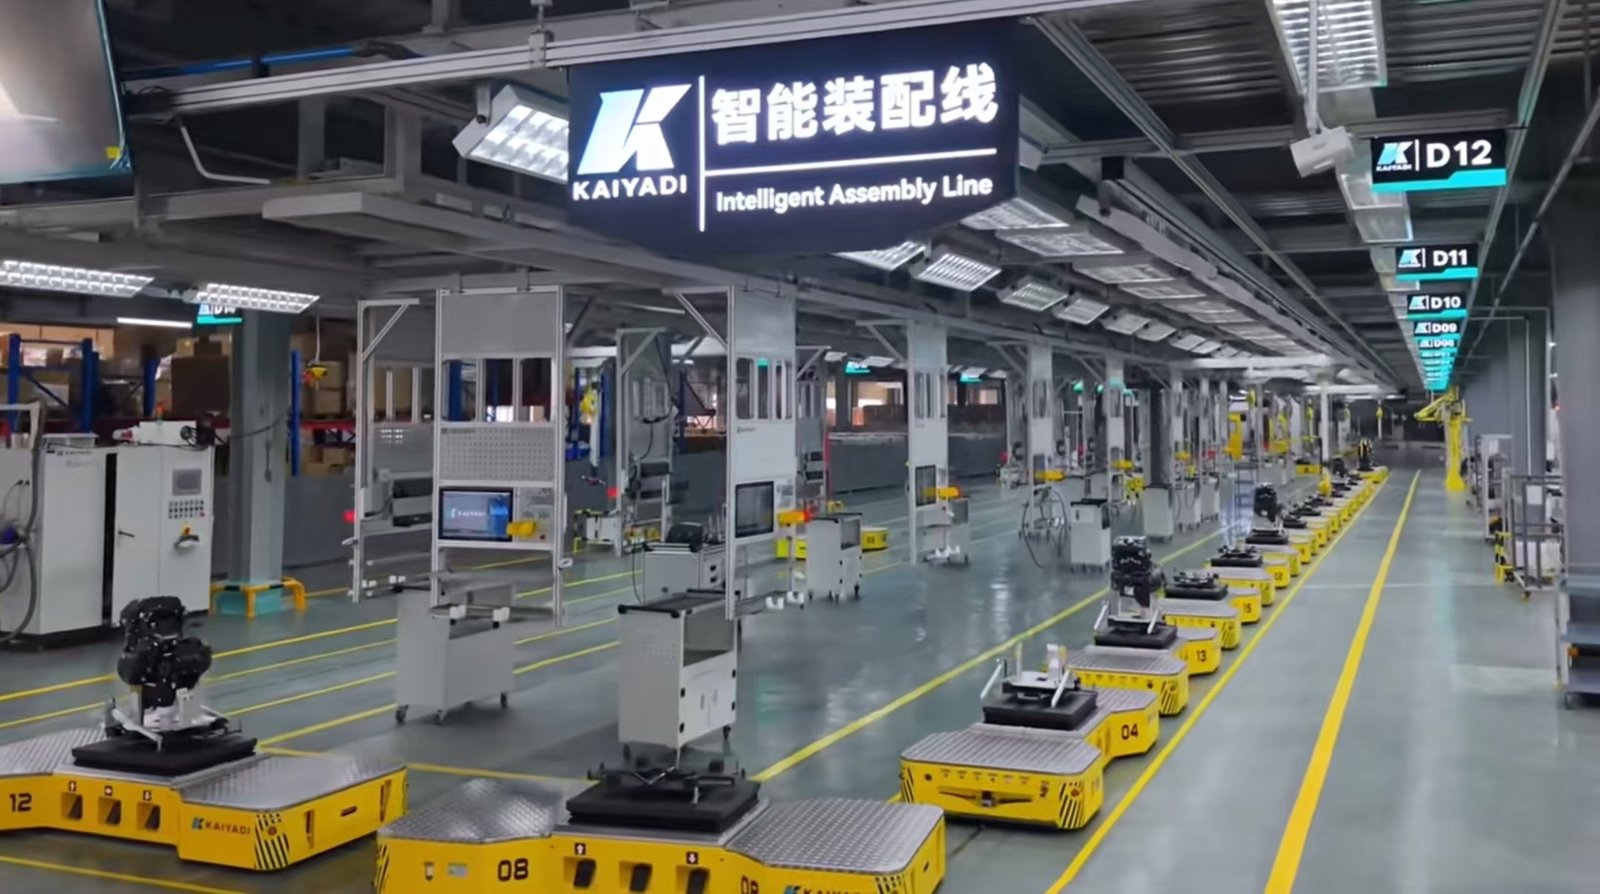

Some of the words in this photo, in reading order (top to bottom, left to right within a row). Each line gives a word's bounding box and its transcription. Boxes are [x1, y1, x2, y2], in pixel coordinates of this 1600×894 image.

[711, 62, 998, 145] 智能装配线
[1426, 139, 1492, 168] D12
[573, 175, 687, 200] KAIYADI
[717, 186, 825, 214] Intelligent
[829, 177, 937, 205] Assembly
[943, 174, 994, 198] Line
[1433, 249, 1468, 266] D11
[1430, 296, 1462, 309] D10
[1432, 323, 1458, 333] D09
[1196, 650, 1207, 662] 13
[1121, 723, 1139, 740] 04
[9, 793, 32, 812] 12
[205, 821, 251, 835] KAIYADI
[498, 858, 529, 882] 08
